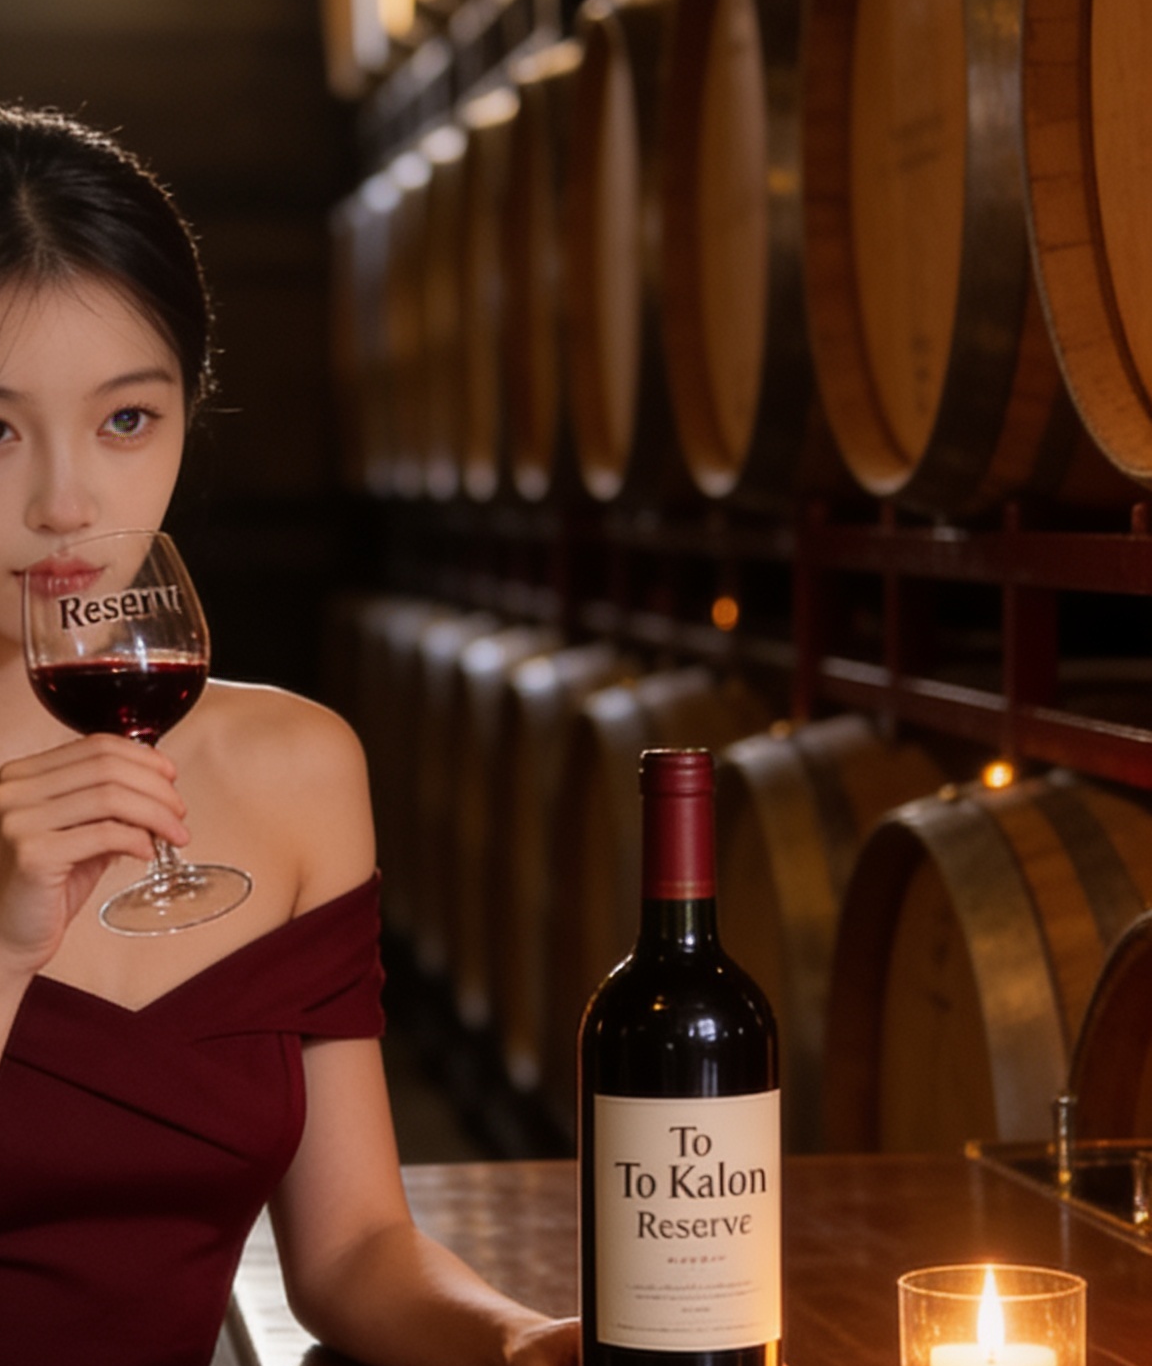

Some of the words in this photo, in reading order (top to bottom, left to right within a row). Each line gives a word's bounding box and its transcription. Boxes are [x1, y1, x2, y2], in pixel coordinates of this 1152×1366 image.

[669, 1126, 712, 1158] To
[614, 1161, 656, 1199] To
[669, 1161, 767, 1199] Kalon
[637, 1210, 752, 1240] Reserve
